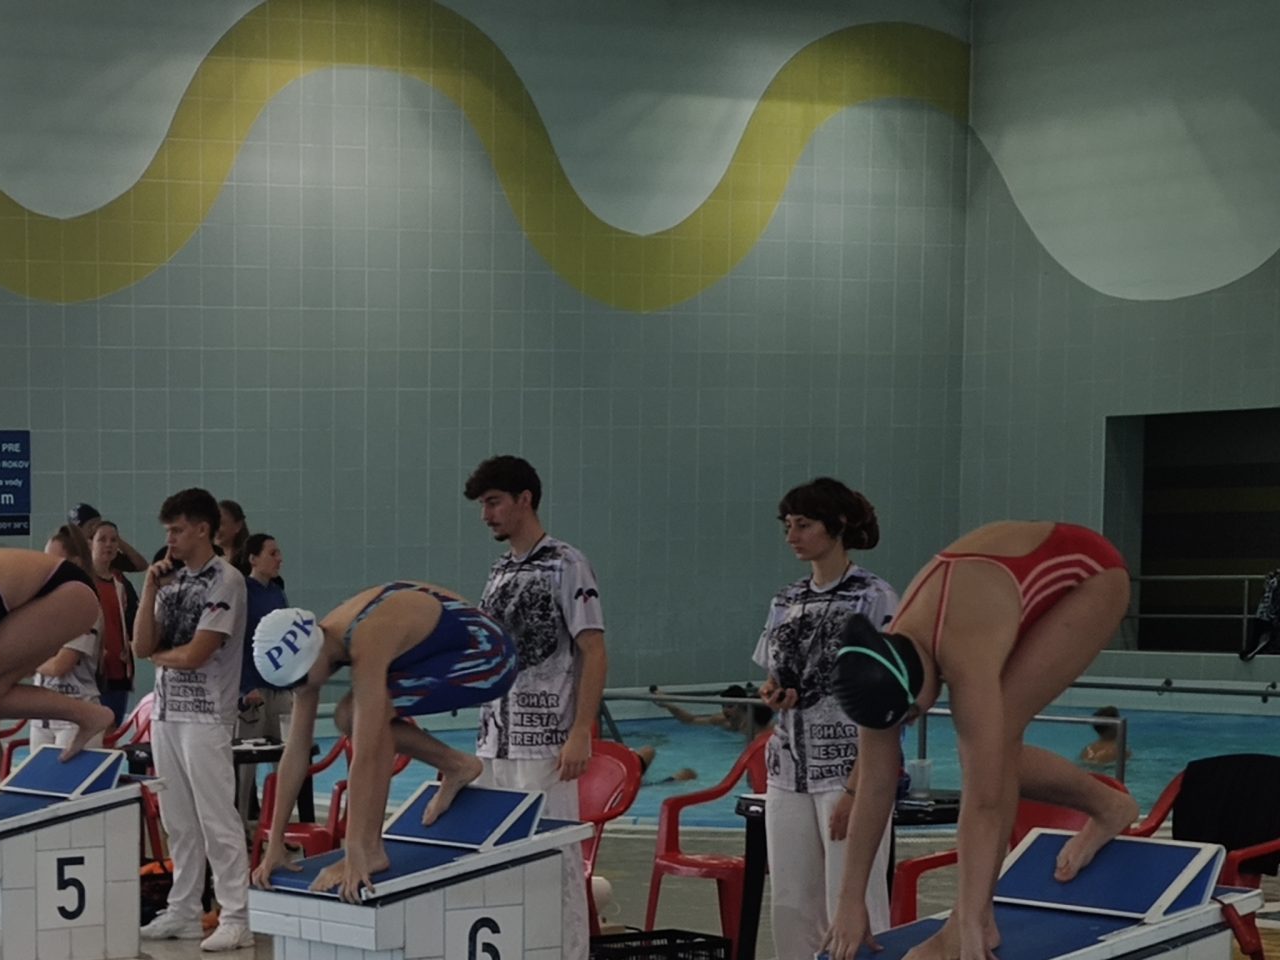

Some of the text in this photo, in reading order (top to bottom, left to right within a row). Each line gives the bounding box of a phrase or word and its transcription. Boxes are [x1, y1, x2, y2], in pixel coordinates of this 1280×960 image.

[2, 443, 21, 452] PRE
[1, 494, 14, 504] m
[265, 611, 314, 672] PPK
[512, 690, 560, 708] POHÁR
[810, 721, 858, 739] POHÁR
[809, 759, 855, 780] TRENČ
[56, 856, 86, 922] 5
